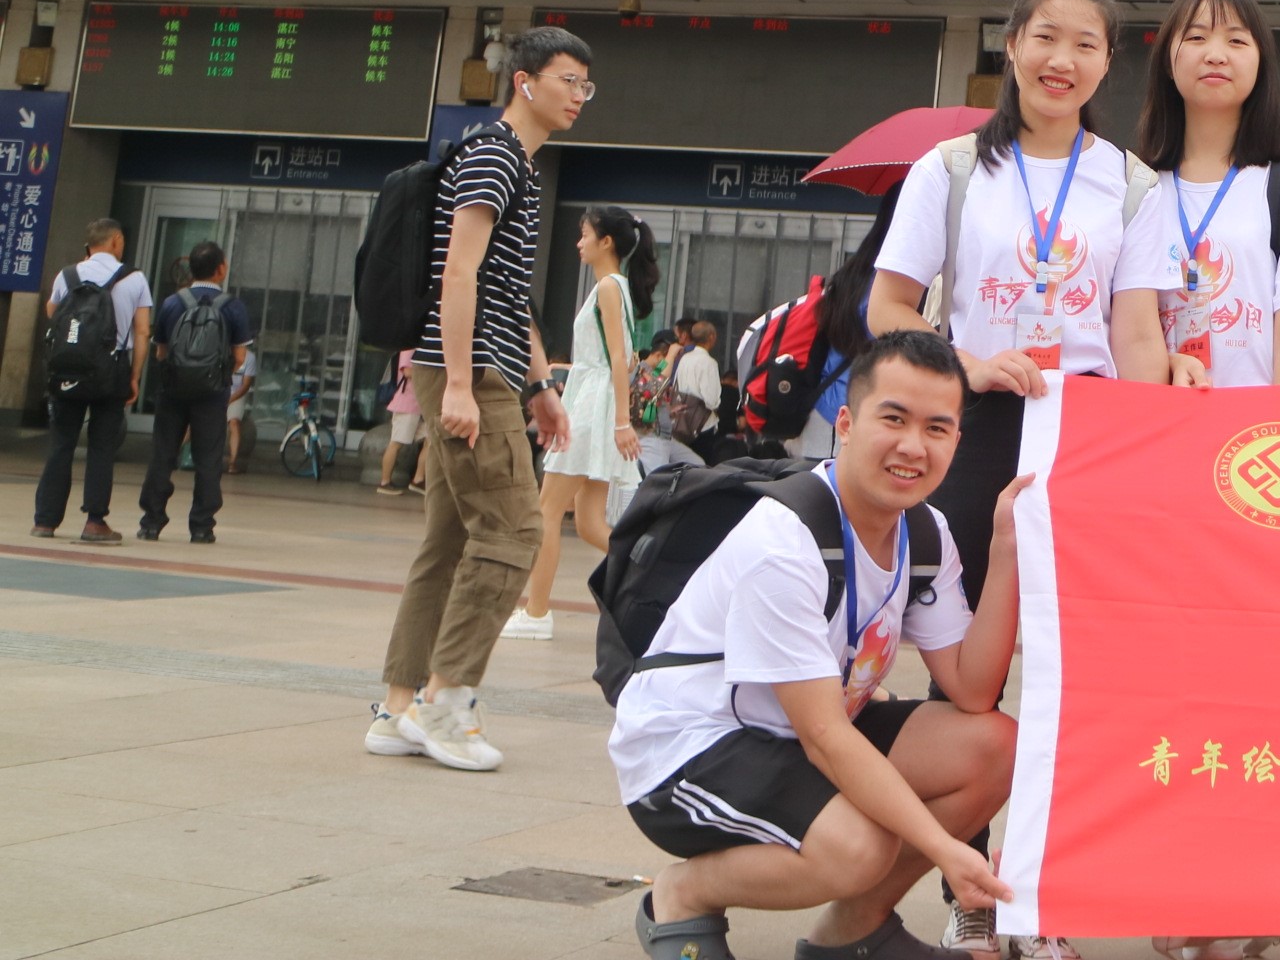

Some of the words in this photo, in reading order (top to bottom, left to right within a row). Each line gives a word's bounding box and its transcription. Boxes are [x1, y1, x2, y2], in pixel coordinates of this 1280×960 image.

[213, 21, 240, 33] 14:08
[371, 24, 393, 37] 候车
[211, 36, 238, 48] 14:16
[275, 37, 296, 50] 南宁
[369, 40, 391, 53] 候车
[208, 51, 235, 63] 14:24
[273, 52, 294, 65] 岳阳
[367, 55, 389, 68] 候车
[365, 70, 387, 83] 候车
[289, 147, 341, 167] 进站口
[287, 168, 329, 180] Entrance
[749, 187, 797, 200] Entrance
[12, 185, 41, 276] 爱心通道
[989, 317, 1017, 326] QINGME
[1184, 342, 1204, 352] 工作证
[1225, 339, 1247, 347] HUIGE
[1220, 441, 1246, 486] CENTRAL
